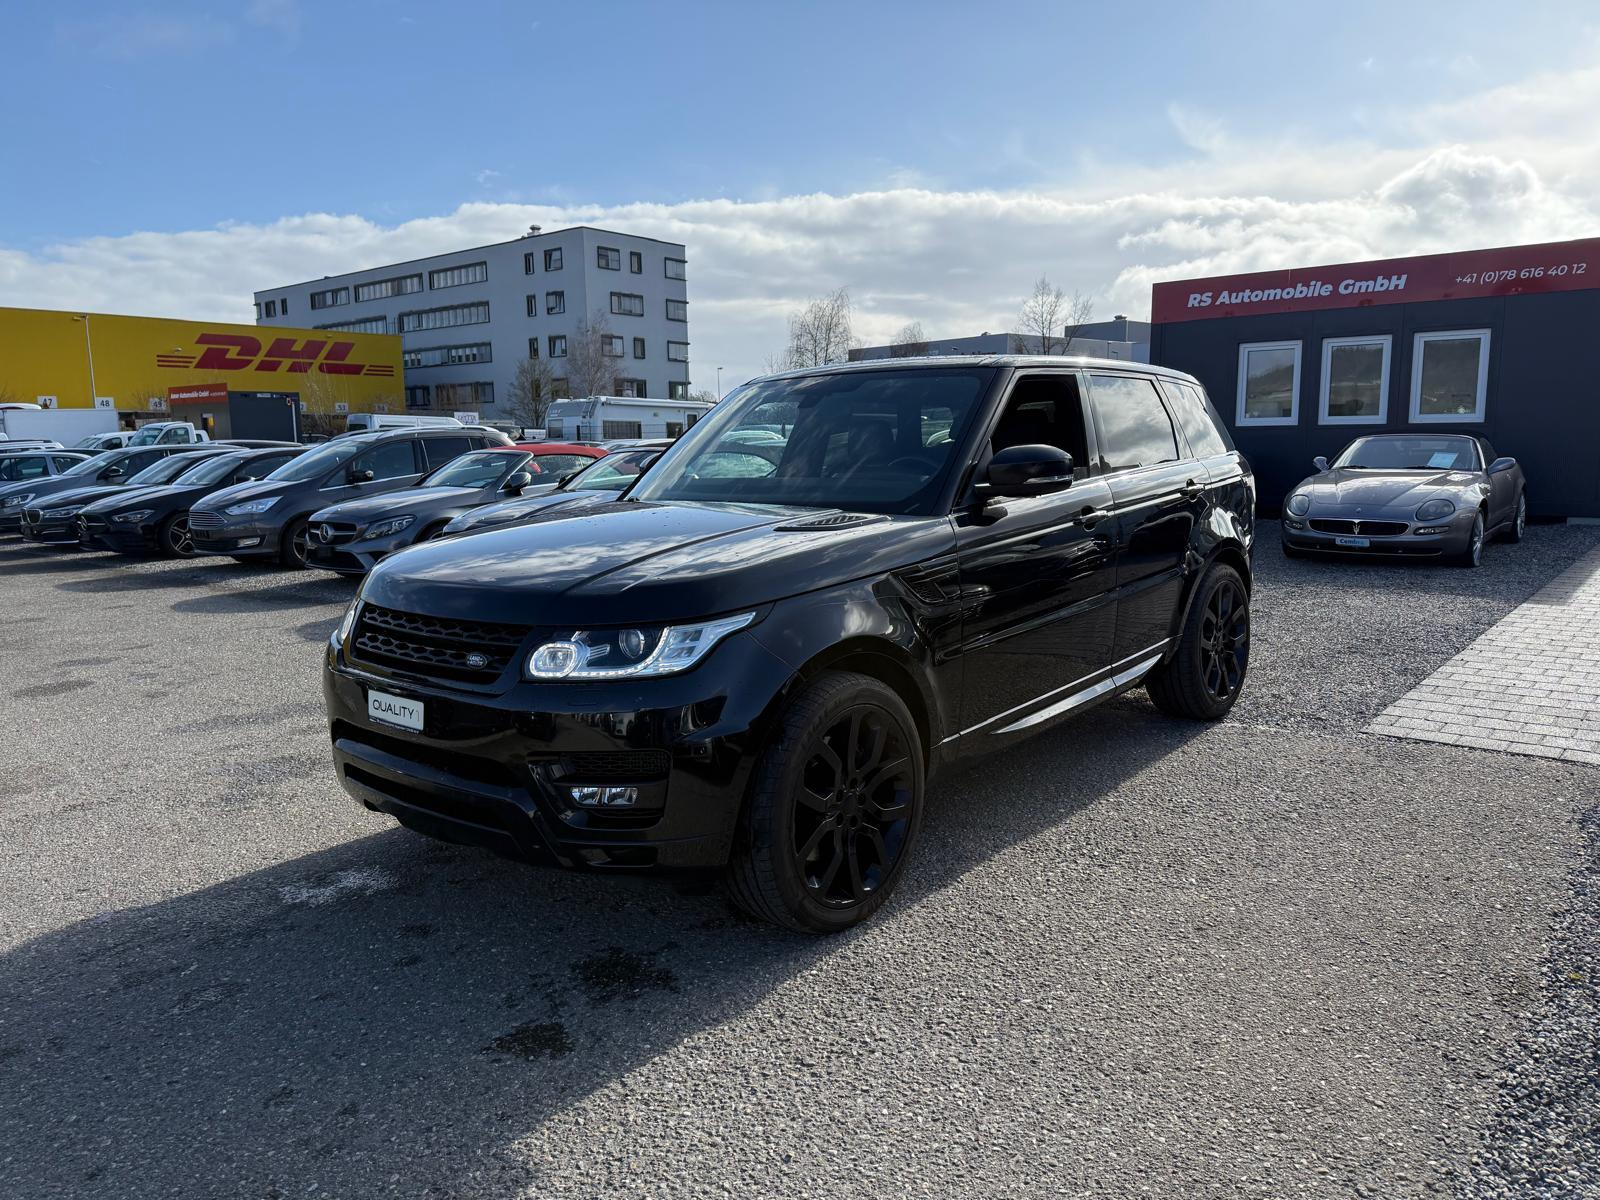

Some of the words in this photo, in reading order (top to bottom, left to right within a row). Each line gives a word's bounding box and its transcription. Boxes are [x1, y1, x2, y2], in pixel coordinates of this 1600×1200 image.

[1456, 273, 1478, 284] +41
[1480, 269, 1517, 285] (0)78
[1520, 266, 1545, 279] 616
[1547, 264, 1568, 276] 40
[1571, 263, 1587, 274] 12
[1187, 291, 1214, 308] RS
[1215, 280, 1334, 305] Automobile
[1338, 273, 1408, 295] GmbH
[194, 332, 366, 375] DHL
[100, 399, 110, 407] 48
